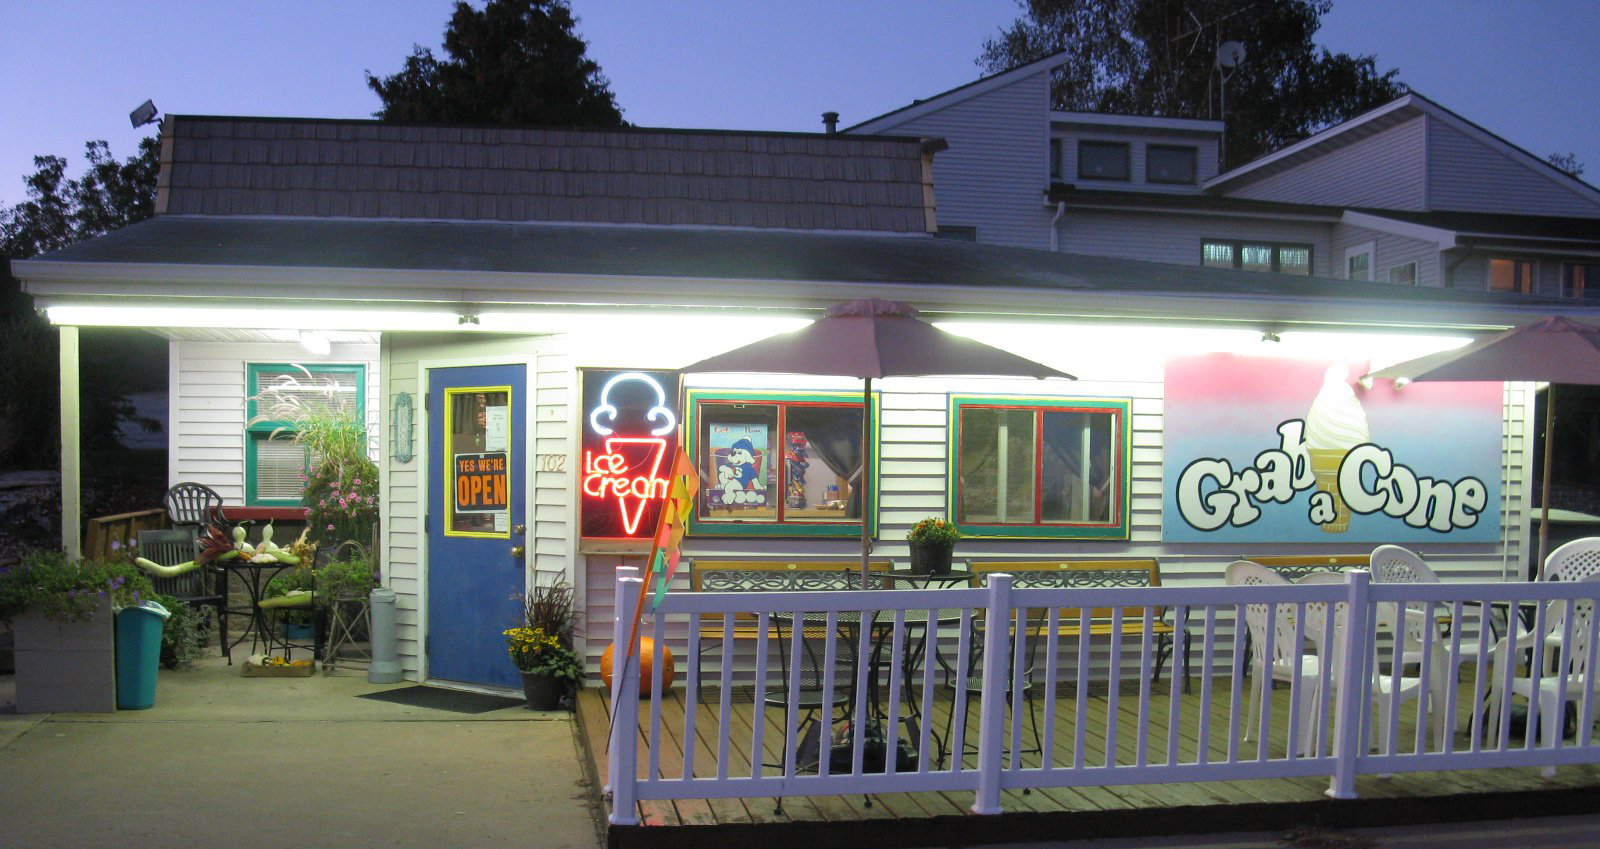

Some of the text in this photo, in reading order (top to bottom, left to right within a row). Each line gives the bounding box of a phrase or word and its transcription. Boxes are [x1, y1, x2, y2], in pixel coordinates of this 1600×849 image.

[459, 458, 504, 472] YES WE'RE
[542, 454, 566, 472] 102
[586, 450, 629, 474] Ice
[583, 473, 670, 499] Cream
[1176, 418, 1488, 533] Grab a Cone
[458, 474, 506, 507] OPEN
